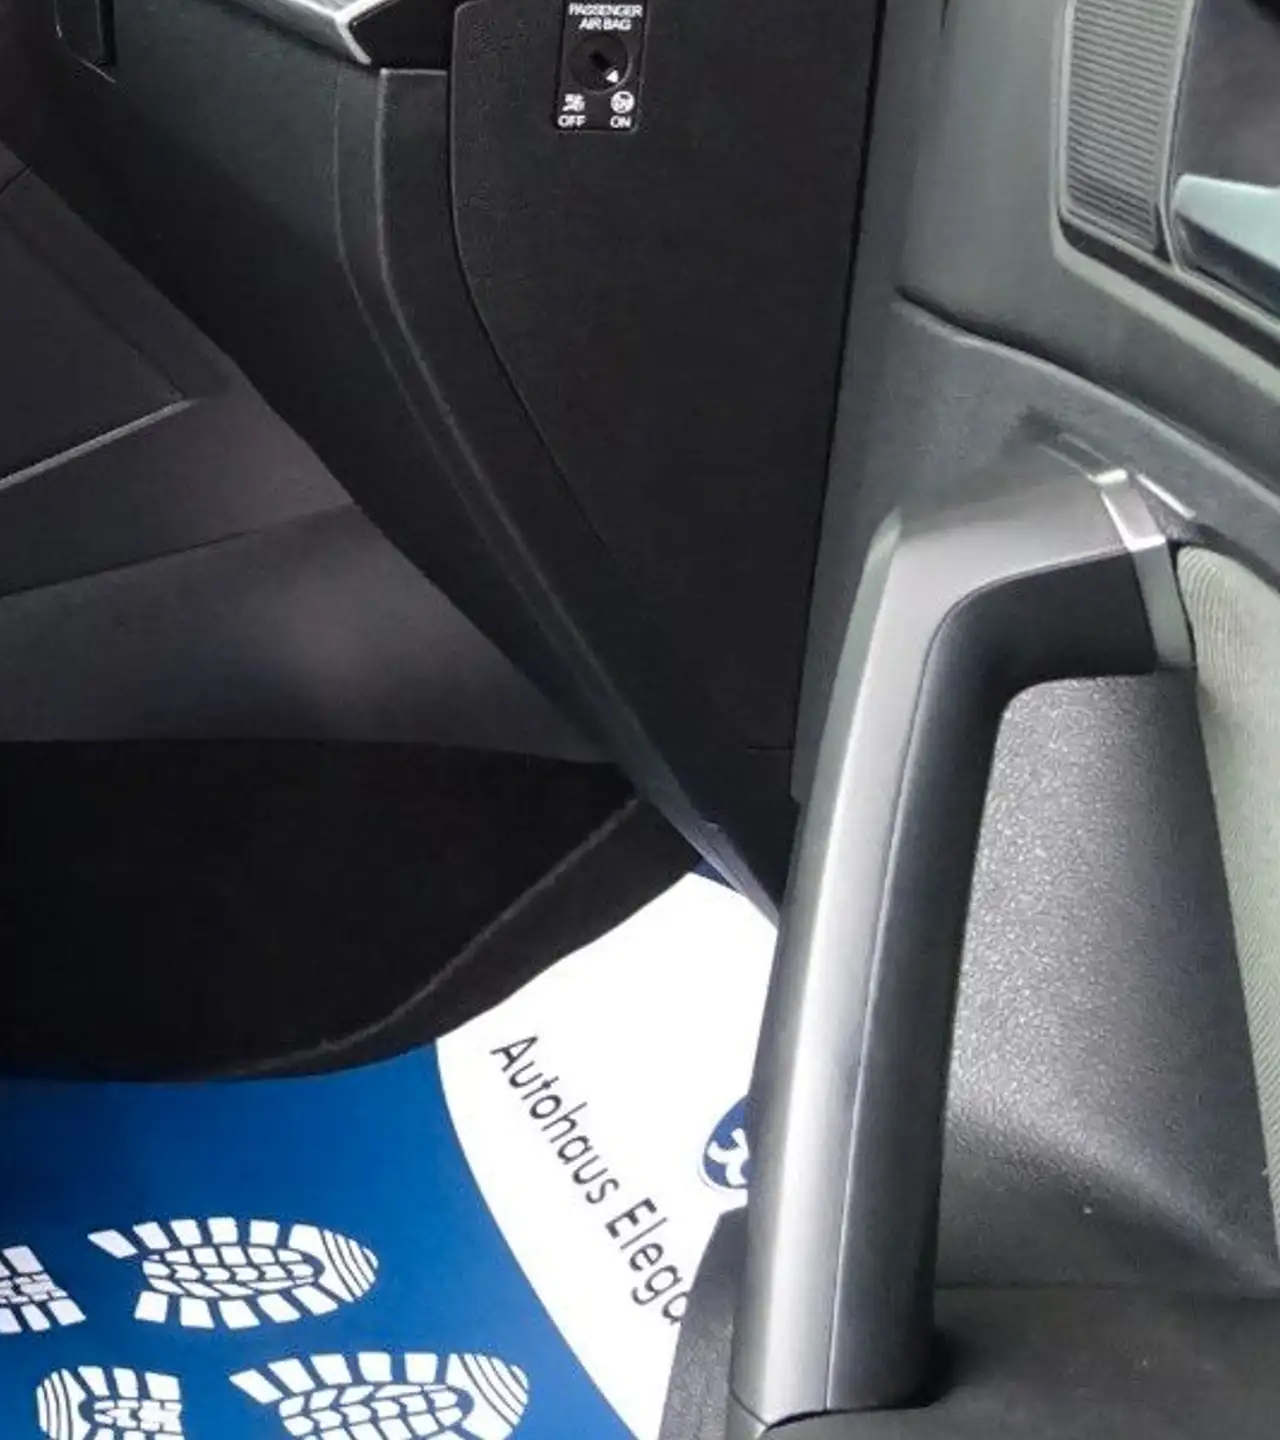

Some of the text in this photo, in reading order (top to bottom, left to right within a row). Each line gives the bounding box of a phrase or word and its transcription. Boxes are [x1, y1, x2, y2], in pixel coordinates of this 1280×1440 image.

[568, 3, 643, 18] PASSENGER
[558, 114, 586, 128] OFF
[610, 115, 632, 129] ON
[489, 1035, 620, 1204] Autohaus
